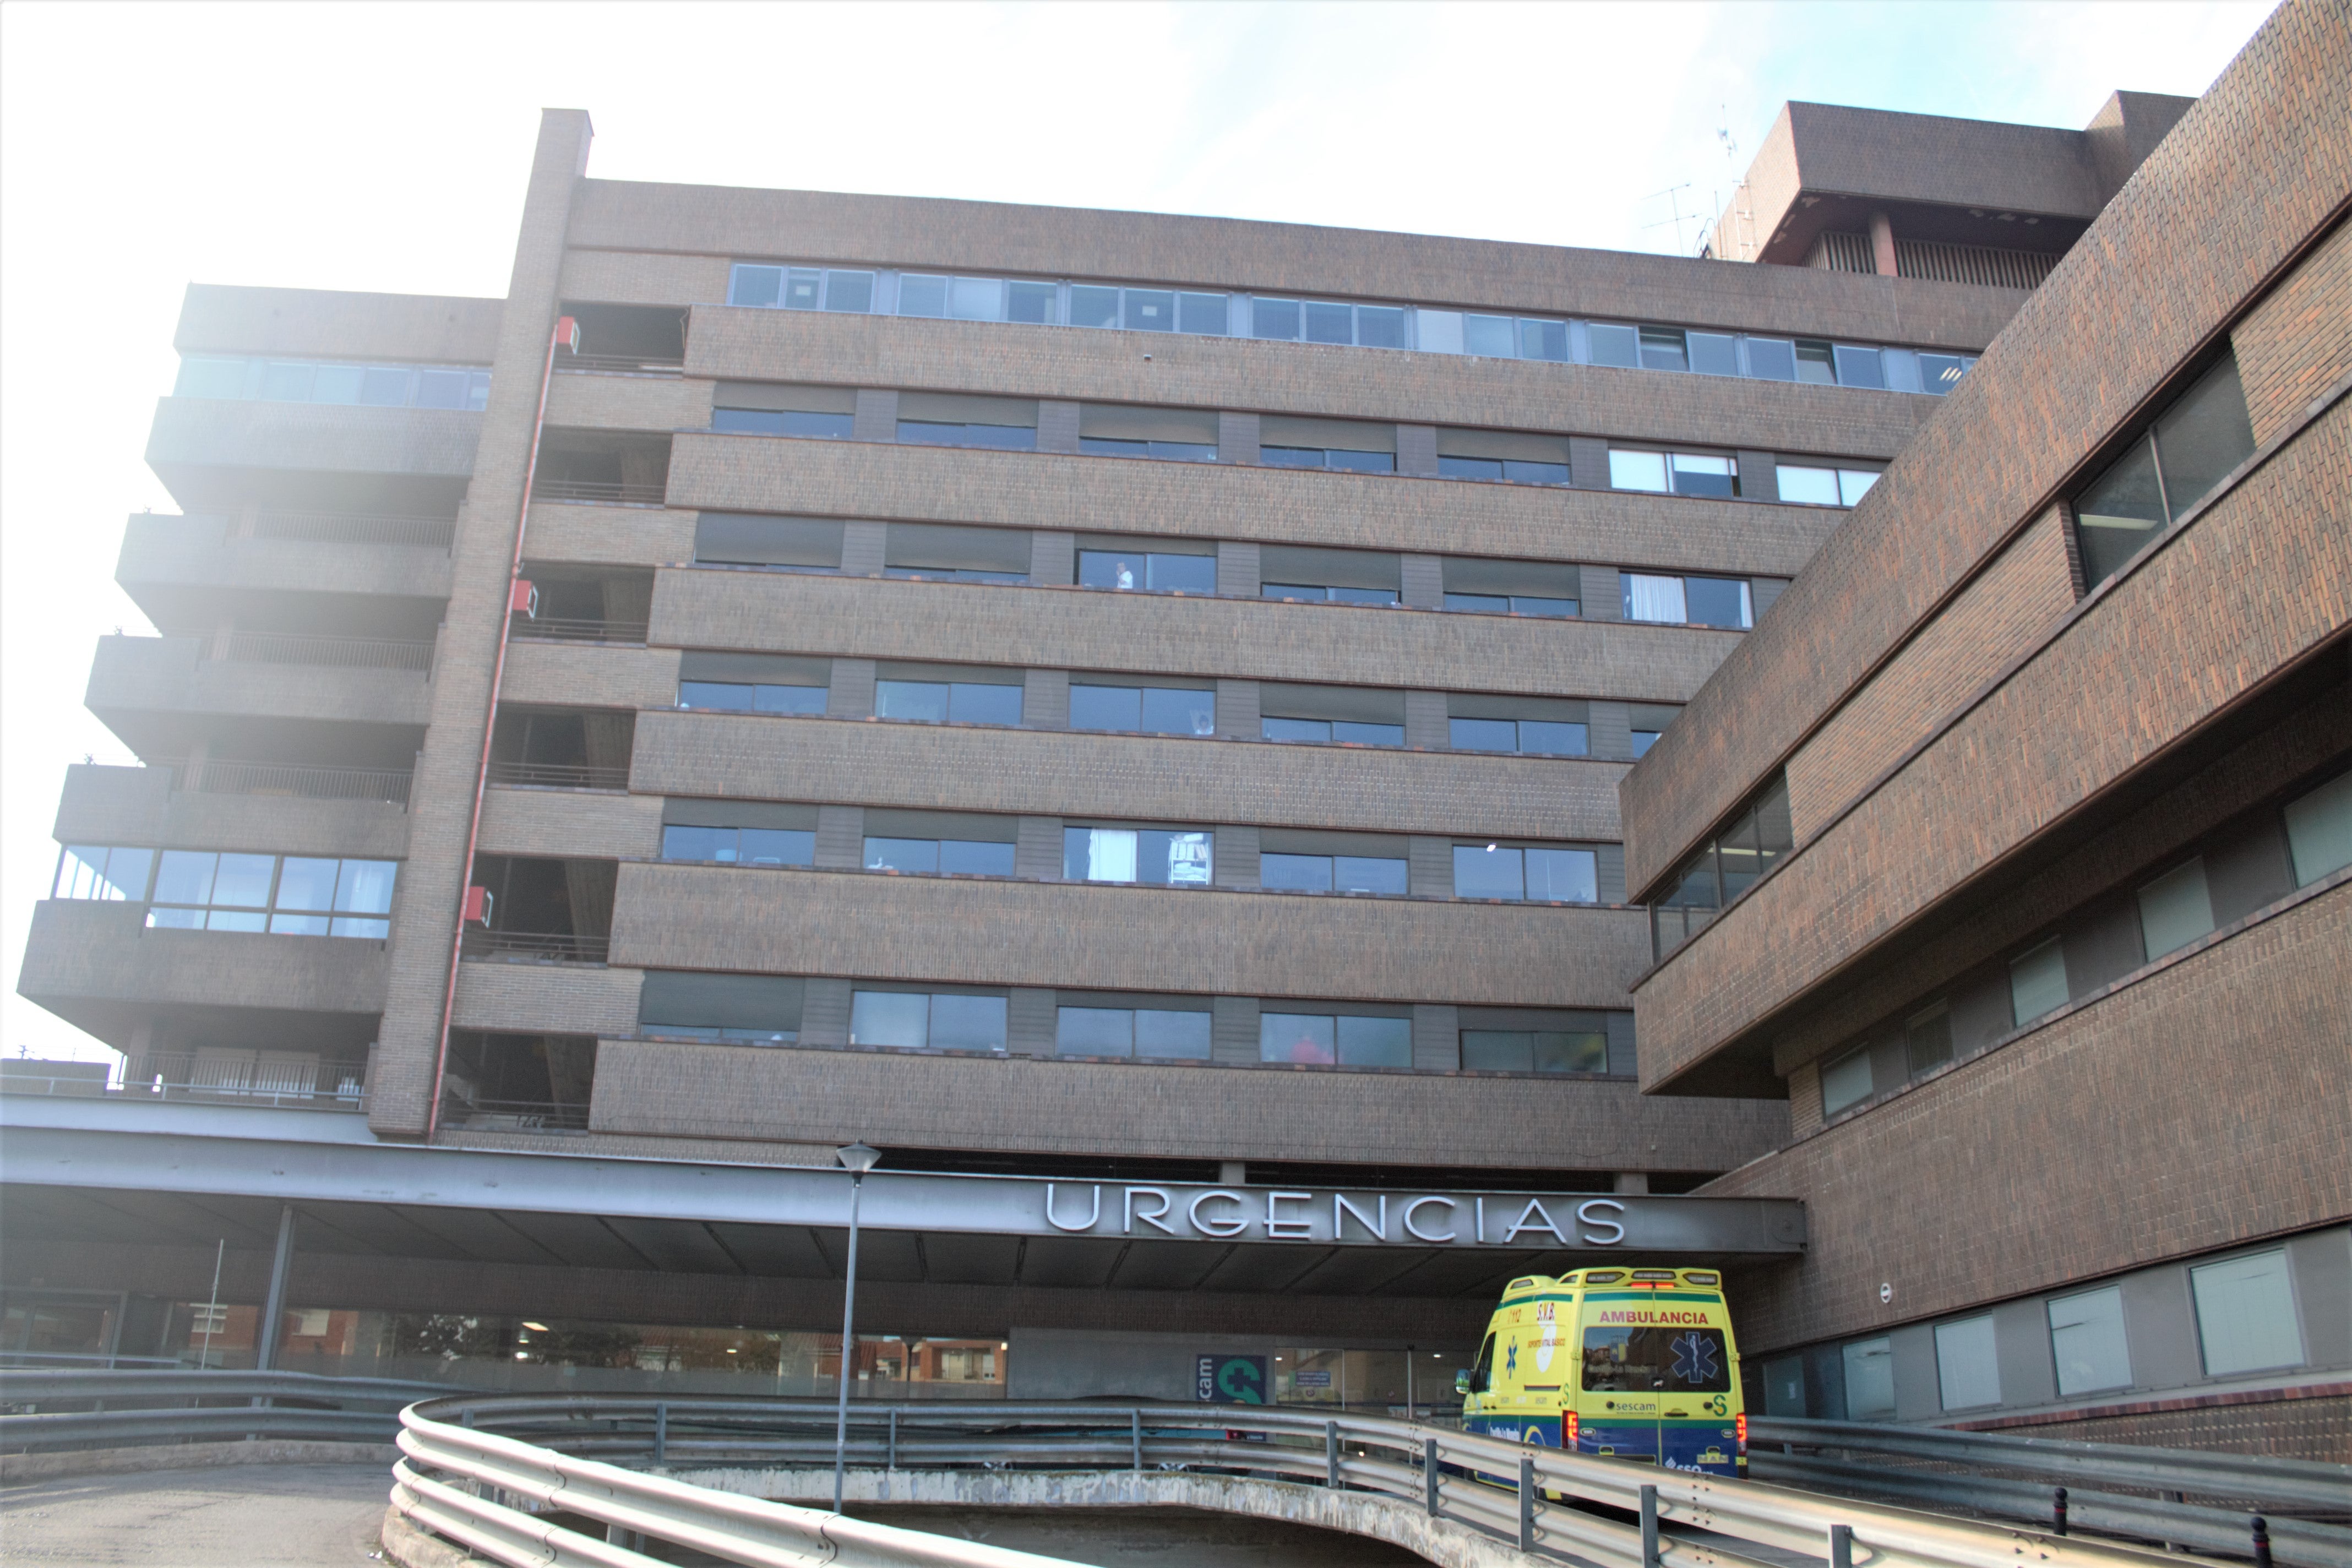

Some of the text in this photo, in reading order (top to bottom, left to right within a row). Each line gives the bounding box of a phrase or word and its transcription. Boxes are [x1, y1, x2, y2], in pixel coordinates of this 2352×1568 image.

[1046, 1183, 1626, 1246] URGENCIAS
[1599, 1311, 1709, 1325] AMBULANCIA
[1199, 1358, 1213, 1402] cam
[1616, 1403, 1656, 1411] sescam
